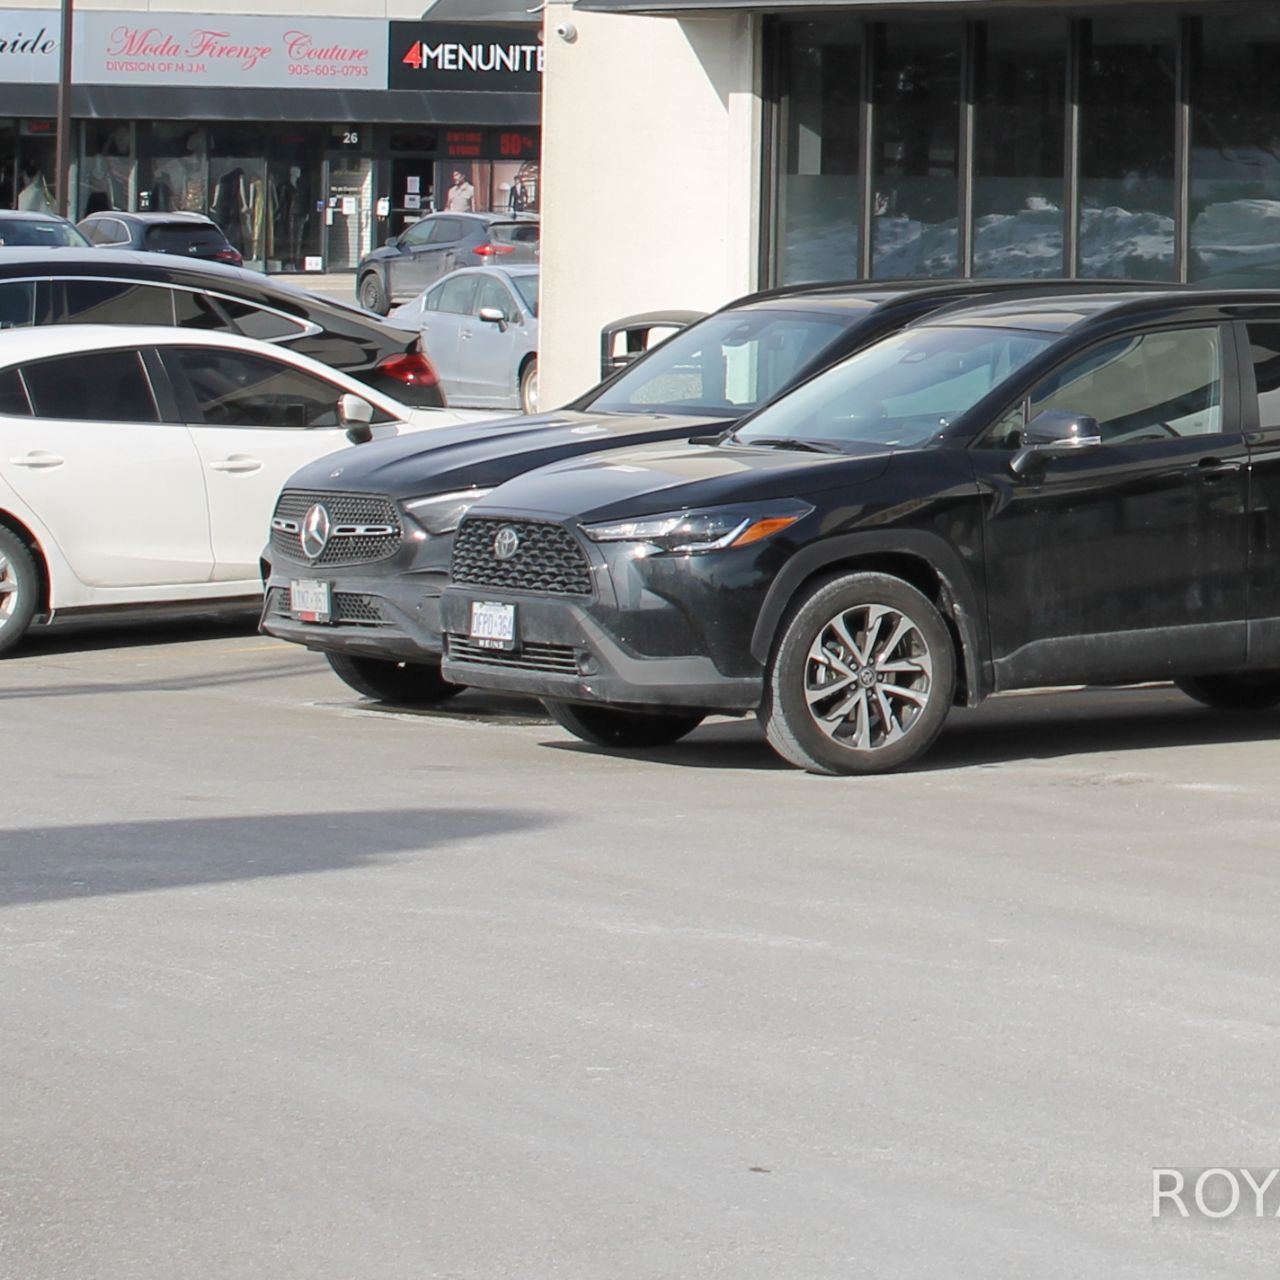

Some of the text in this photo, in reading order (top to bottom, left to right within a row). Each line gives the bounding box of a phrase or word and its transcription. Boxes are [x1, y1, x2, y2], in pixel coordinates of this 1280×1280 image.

[106, 25, 369, 71] Moda Firenze Couture
[106, 61, 155, 72] DIVISION
[158, 62, 173, 73] OF
[287, 64, 369, 76] 905-605-0793
[343, 132, 359, 144] 26
